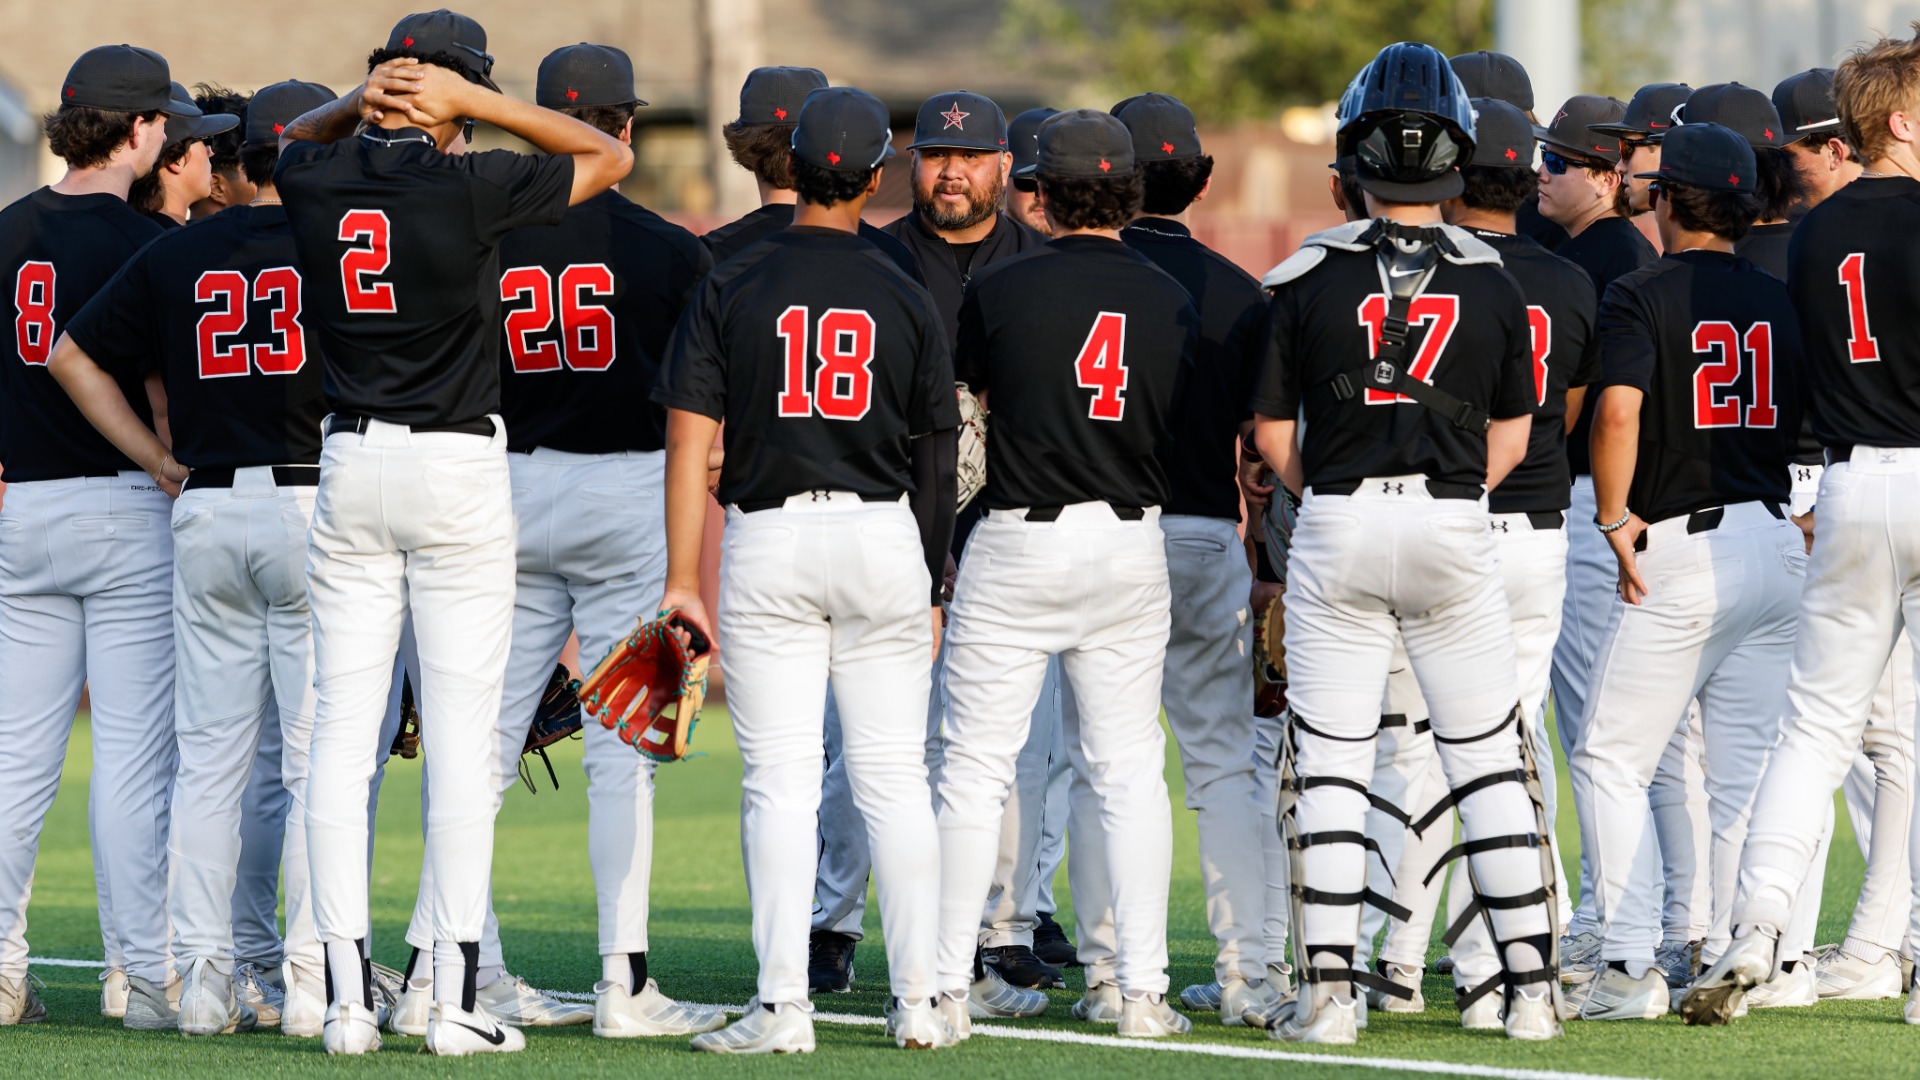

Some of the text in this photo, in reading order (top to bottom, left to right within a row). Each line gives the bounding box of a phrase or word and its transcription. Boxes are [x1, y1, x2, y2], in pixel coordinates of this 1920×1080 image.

[14, 260, 57, 366] 8
[338, 209, 397, 313] 2
[1838, 253, 1881, 363] 1
[194, 266, 307, 379] 23
[500, 263, 616, 372] 26
[776, 305, 877, 422] 18
[1074, 311, 1129, 421] 4
[1357, 293, 1460, 406] 17
[1692, 321, 1778, 429] 21
